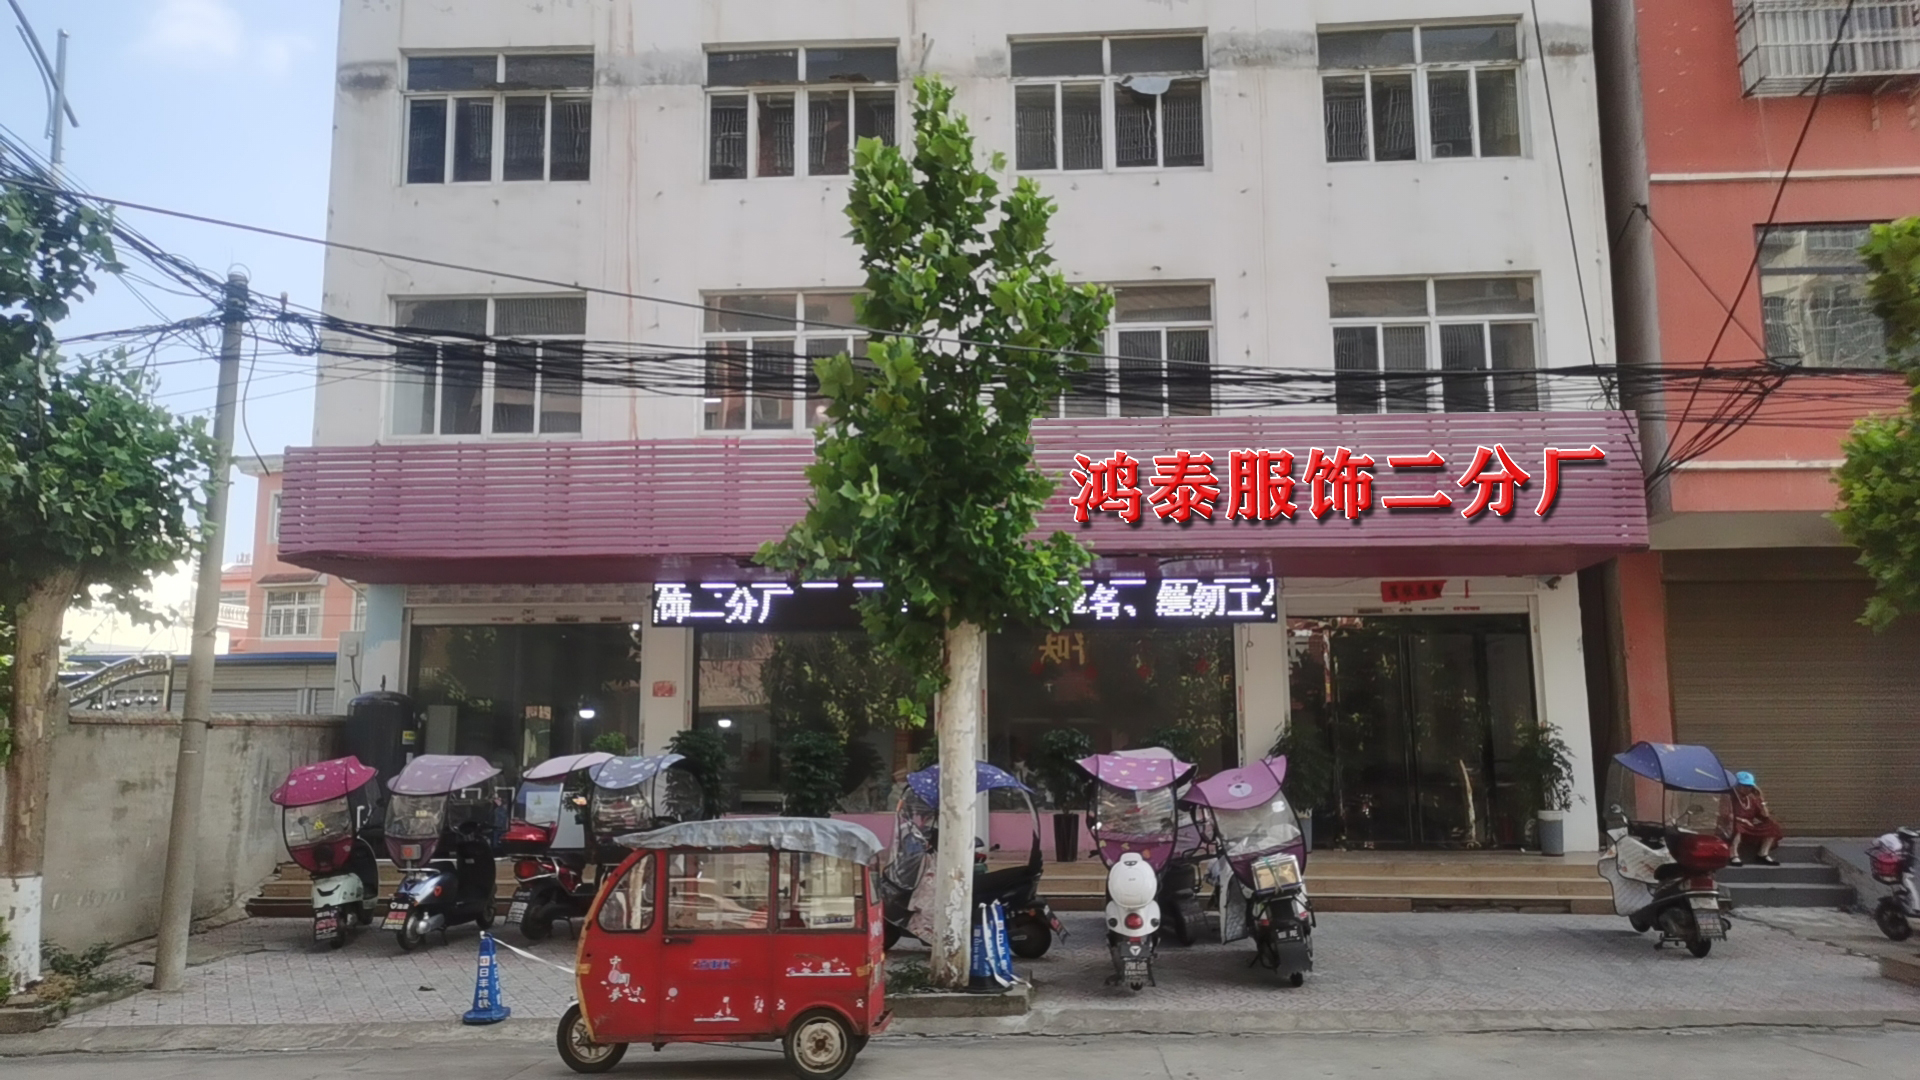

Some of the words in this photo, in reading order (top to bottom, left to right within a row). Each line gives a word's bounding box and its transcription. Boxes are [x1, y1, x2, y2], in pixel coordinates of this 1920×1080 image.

[1070, 444, 1606, 523] 鸿泰服饰二分厂
